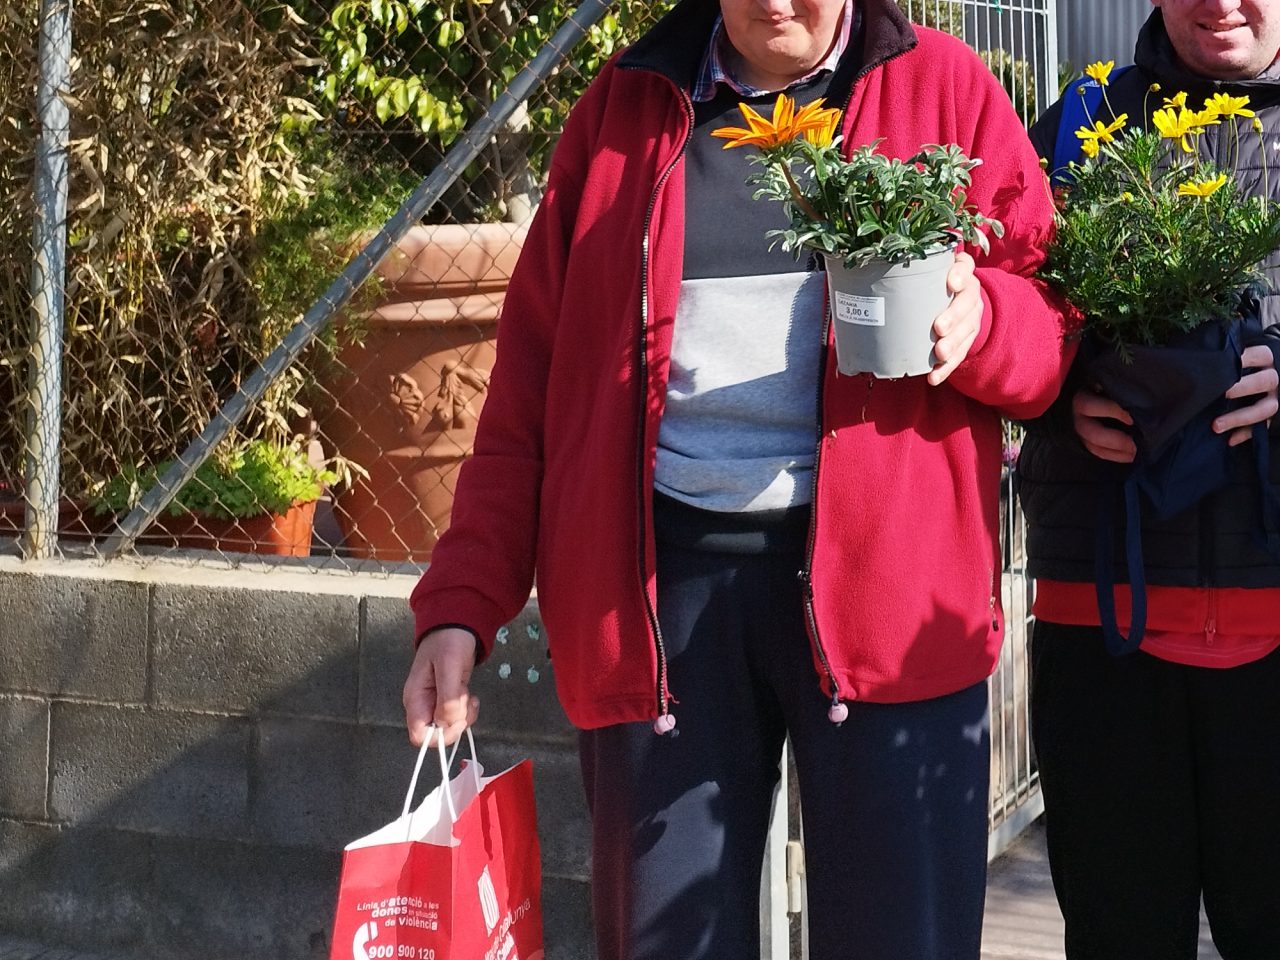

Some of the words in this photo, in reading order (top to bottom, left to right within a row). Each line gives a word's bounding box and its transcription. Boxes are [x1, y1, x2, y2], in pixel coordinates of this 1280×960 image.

[371, 906, 408, 919] dones
[384, 918, 397, 927] de
[368, 945, 394, 959] 900
[398, 944, 416, 959] 900
[417, 947, 435, 960] 120
